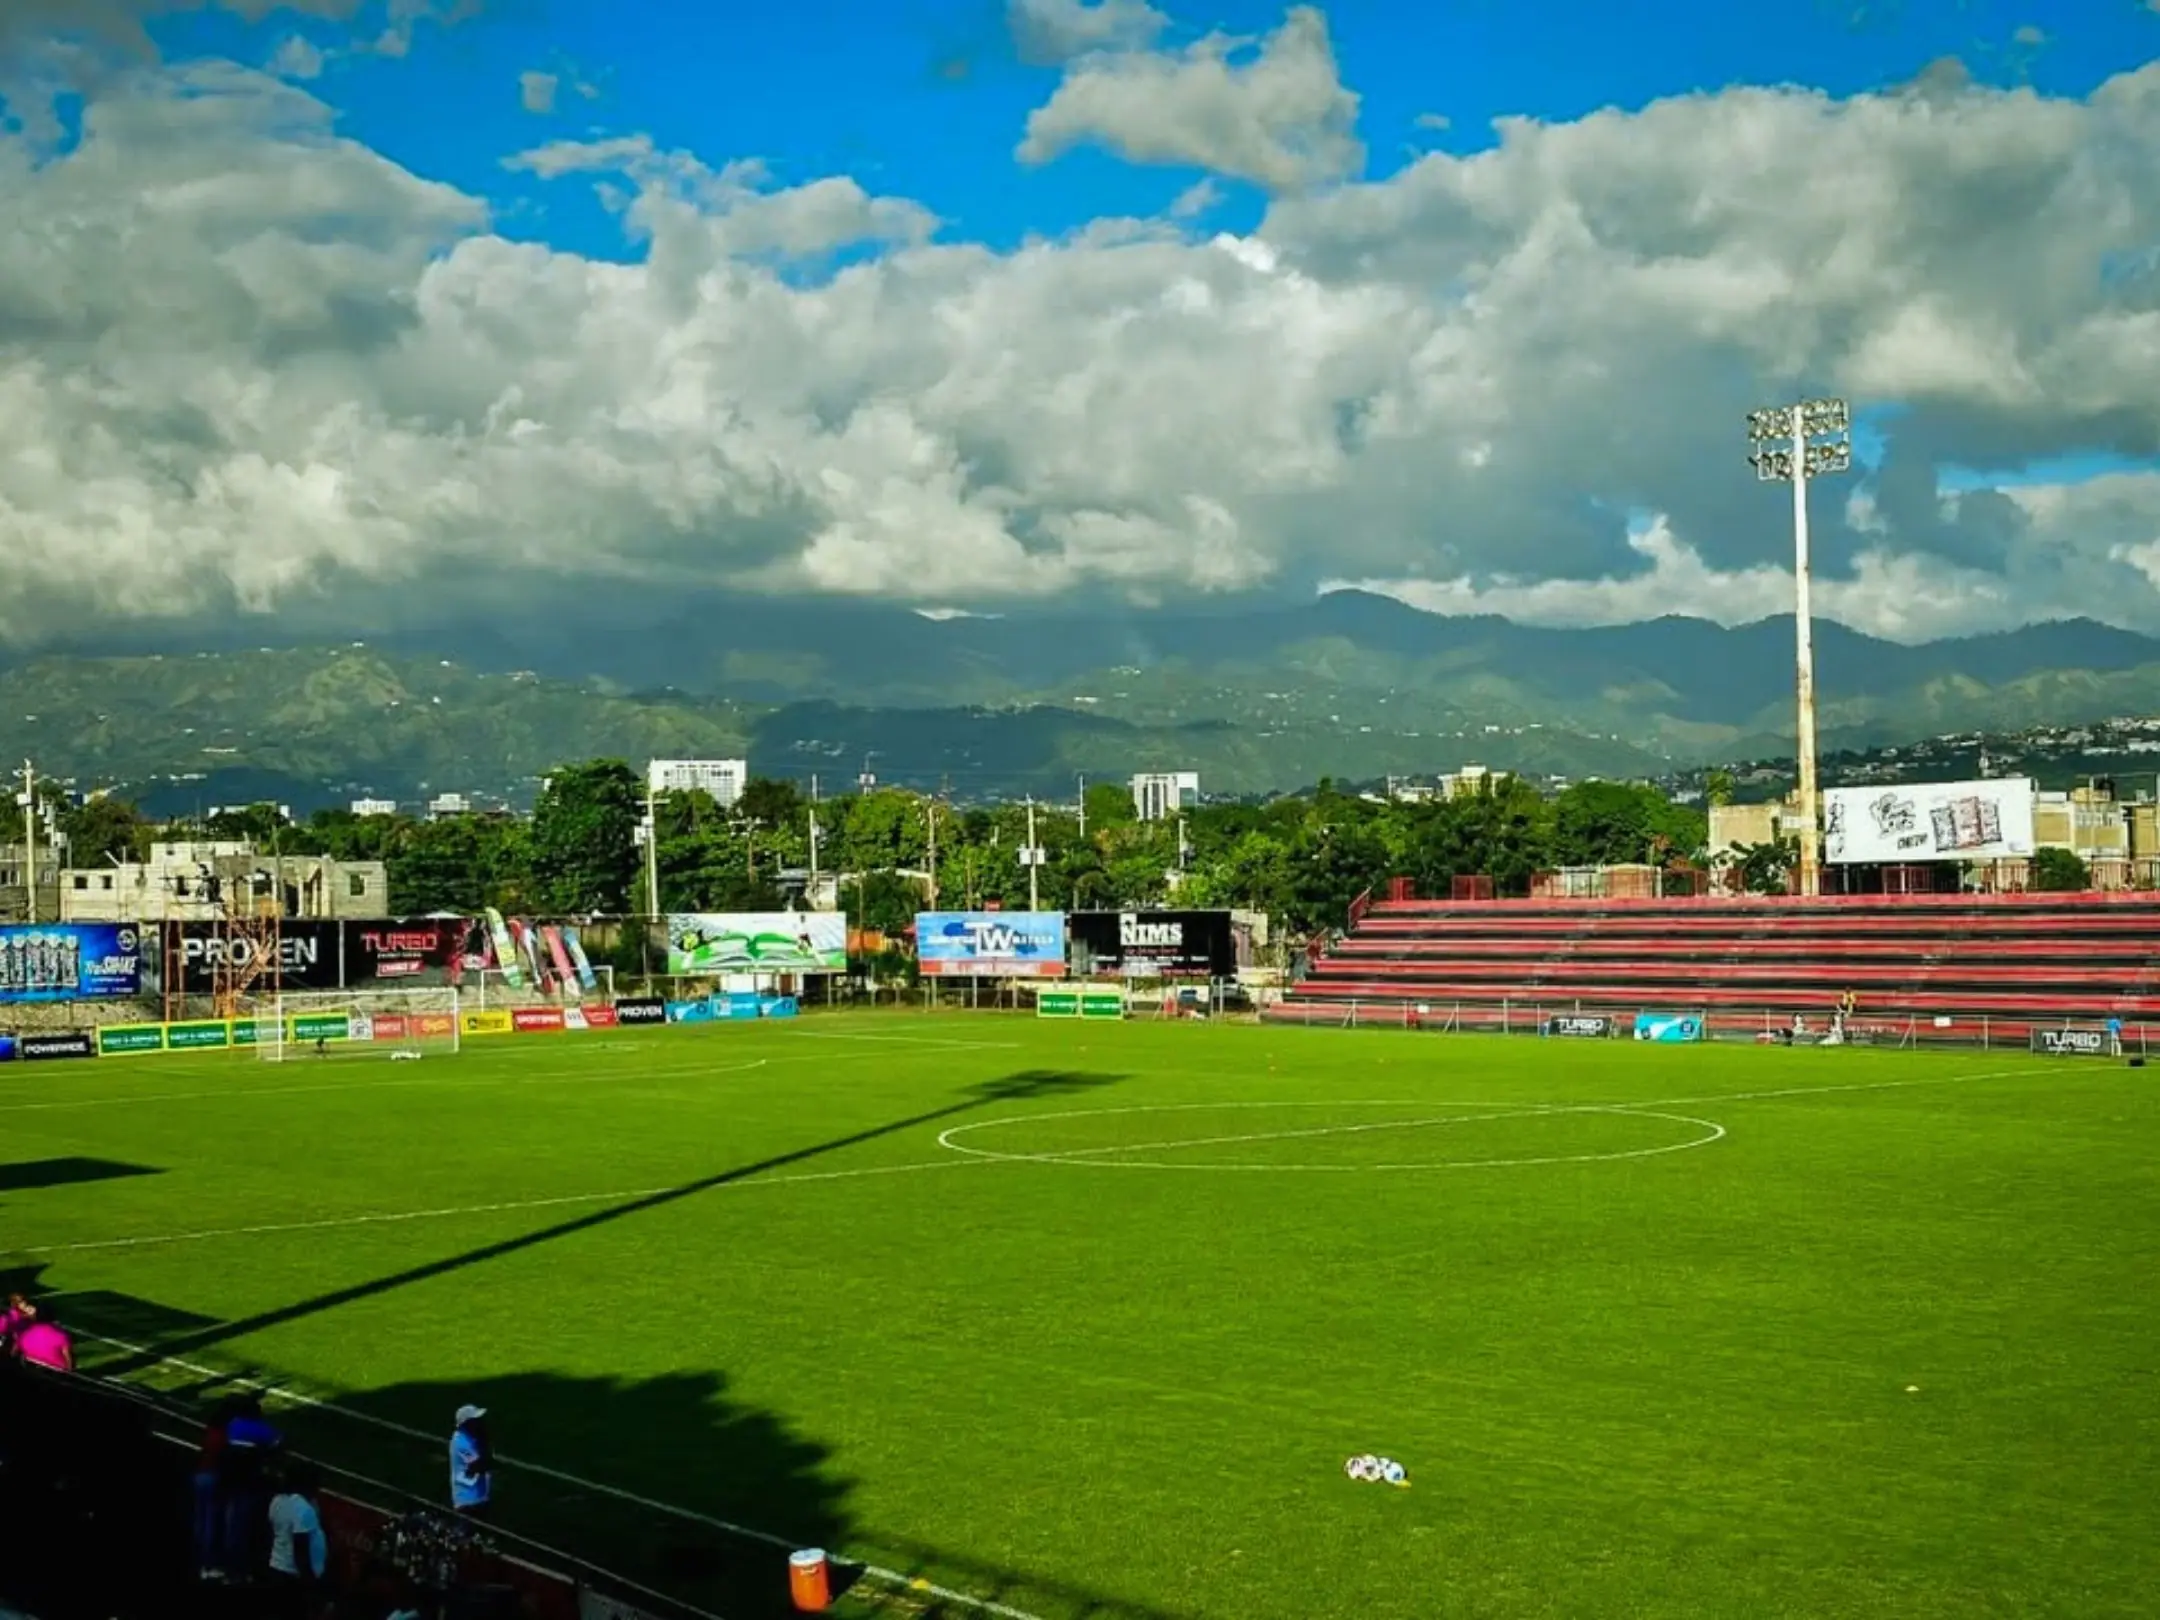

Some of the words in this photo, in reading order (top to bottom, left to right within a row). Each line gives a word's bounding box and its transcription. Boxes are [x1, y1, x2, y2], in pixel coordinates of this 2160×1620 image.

[361, 932, 438, 952] TURBO
[178, 937, 318, 966] PROVEN
[1556, 1017, 1604, 1032] TURBO
[2041, 1031, 2102, 1047] TURBO
